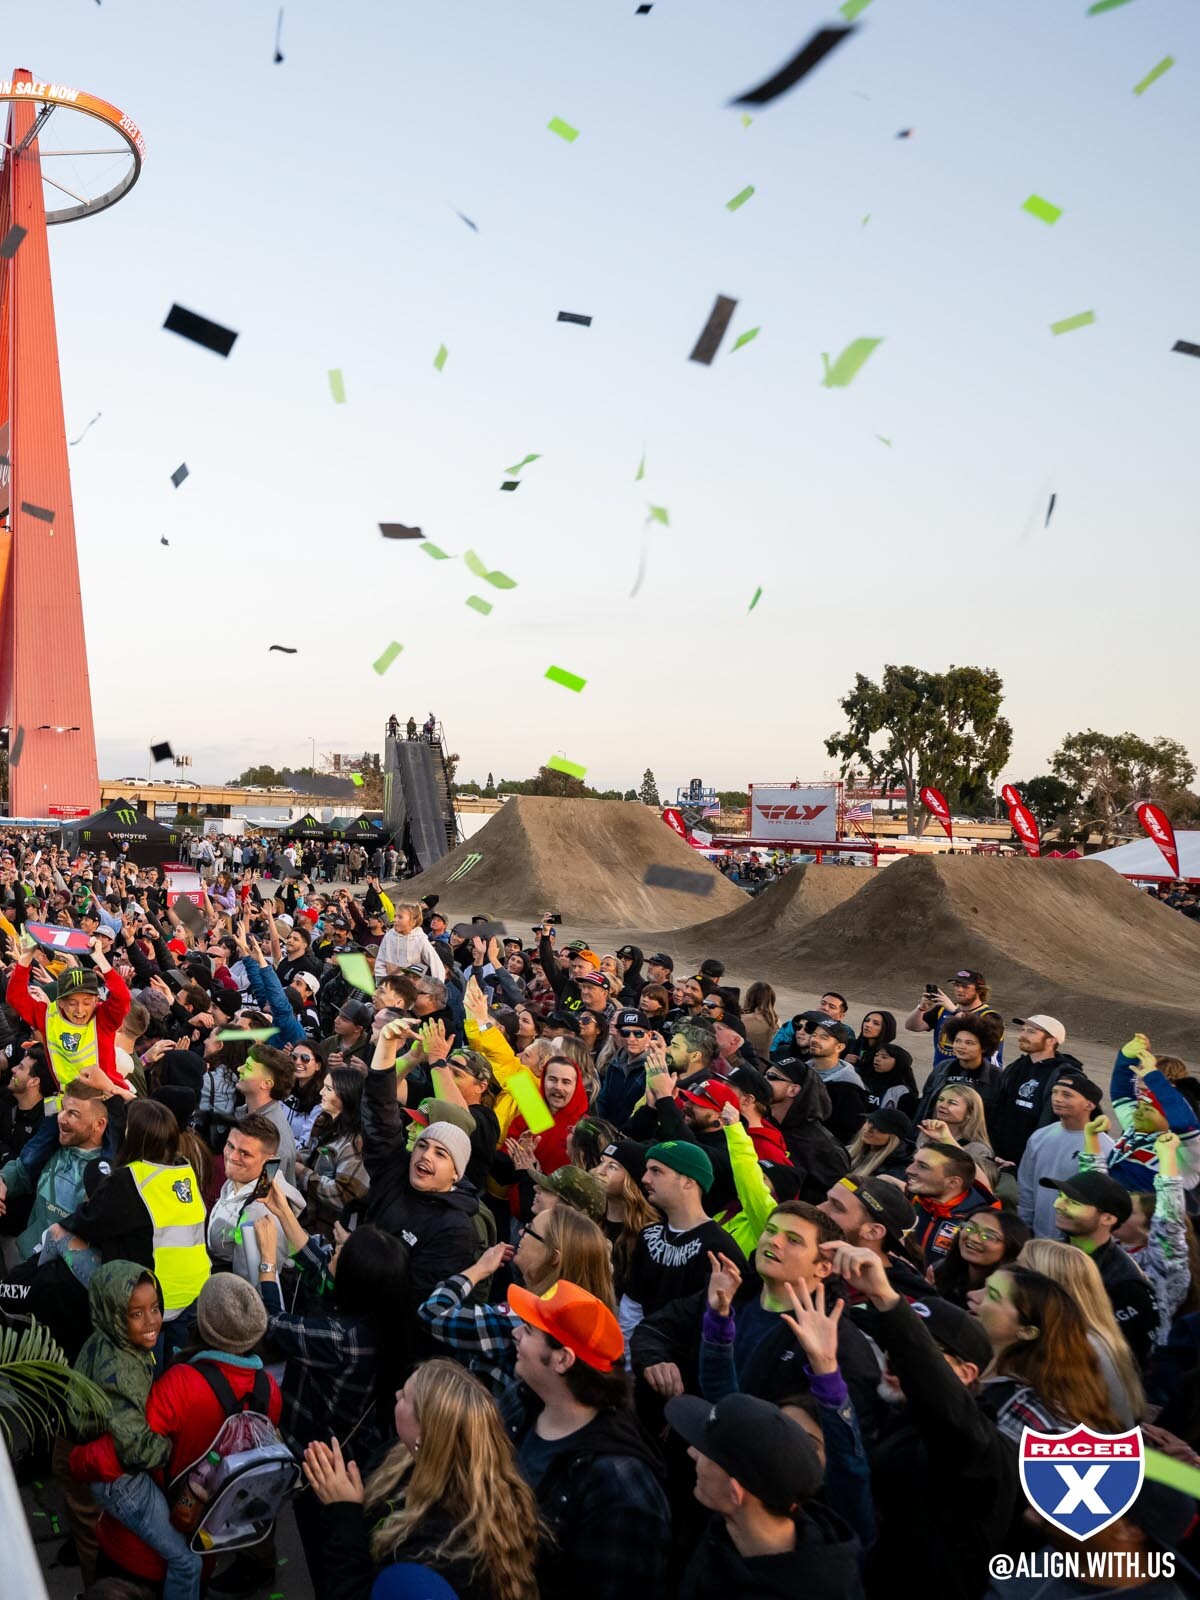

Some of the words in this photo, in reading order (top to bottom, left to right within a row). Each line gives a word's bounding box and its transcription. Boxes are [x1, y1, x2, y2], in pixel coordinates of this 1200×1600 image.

[15, 82, 46, 96] SALE
[48, 85, 79, 102] NOW
[119, 115, 138, 137] 2023
[755, 804, 828, 820] FLY
[113, 832, 148, 840] MONSTER
[49, 930, 71, 946] 1
